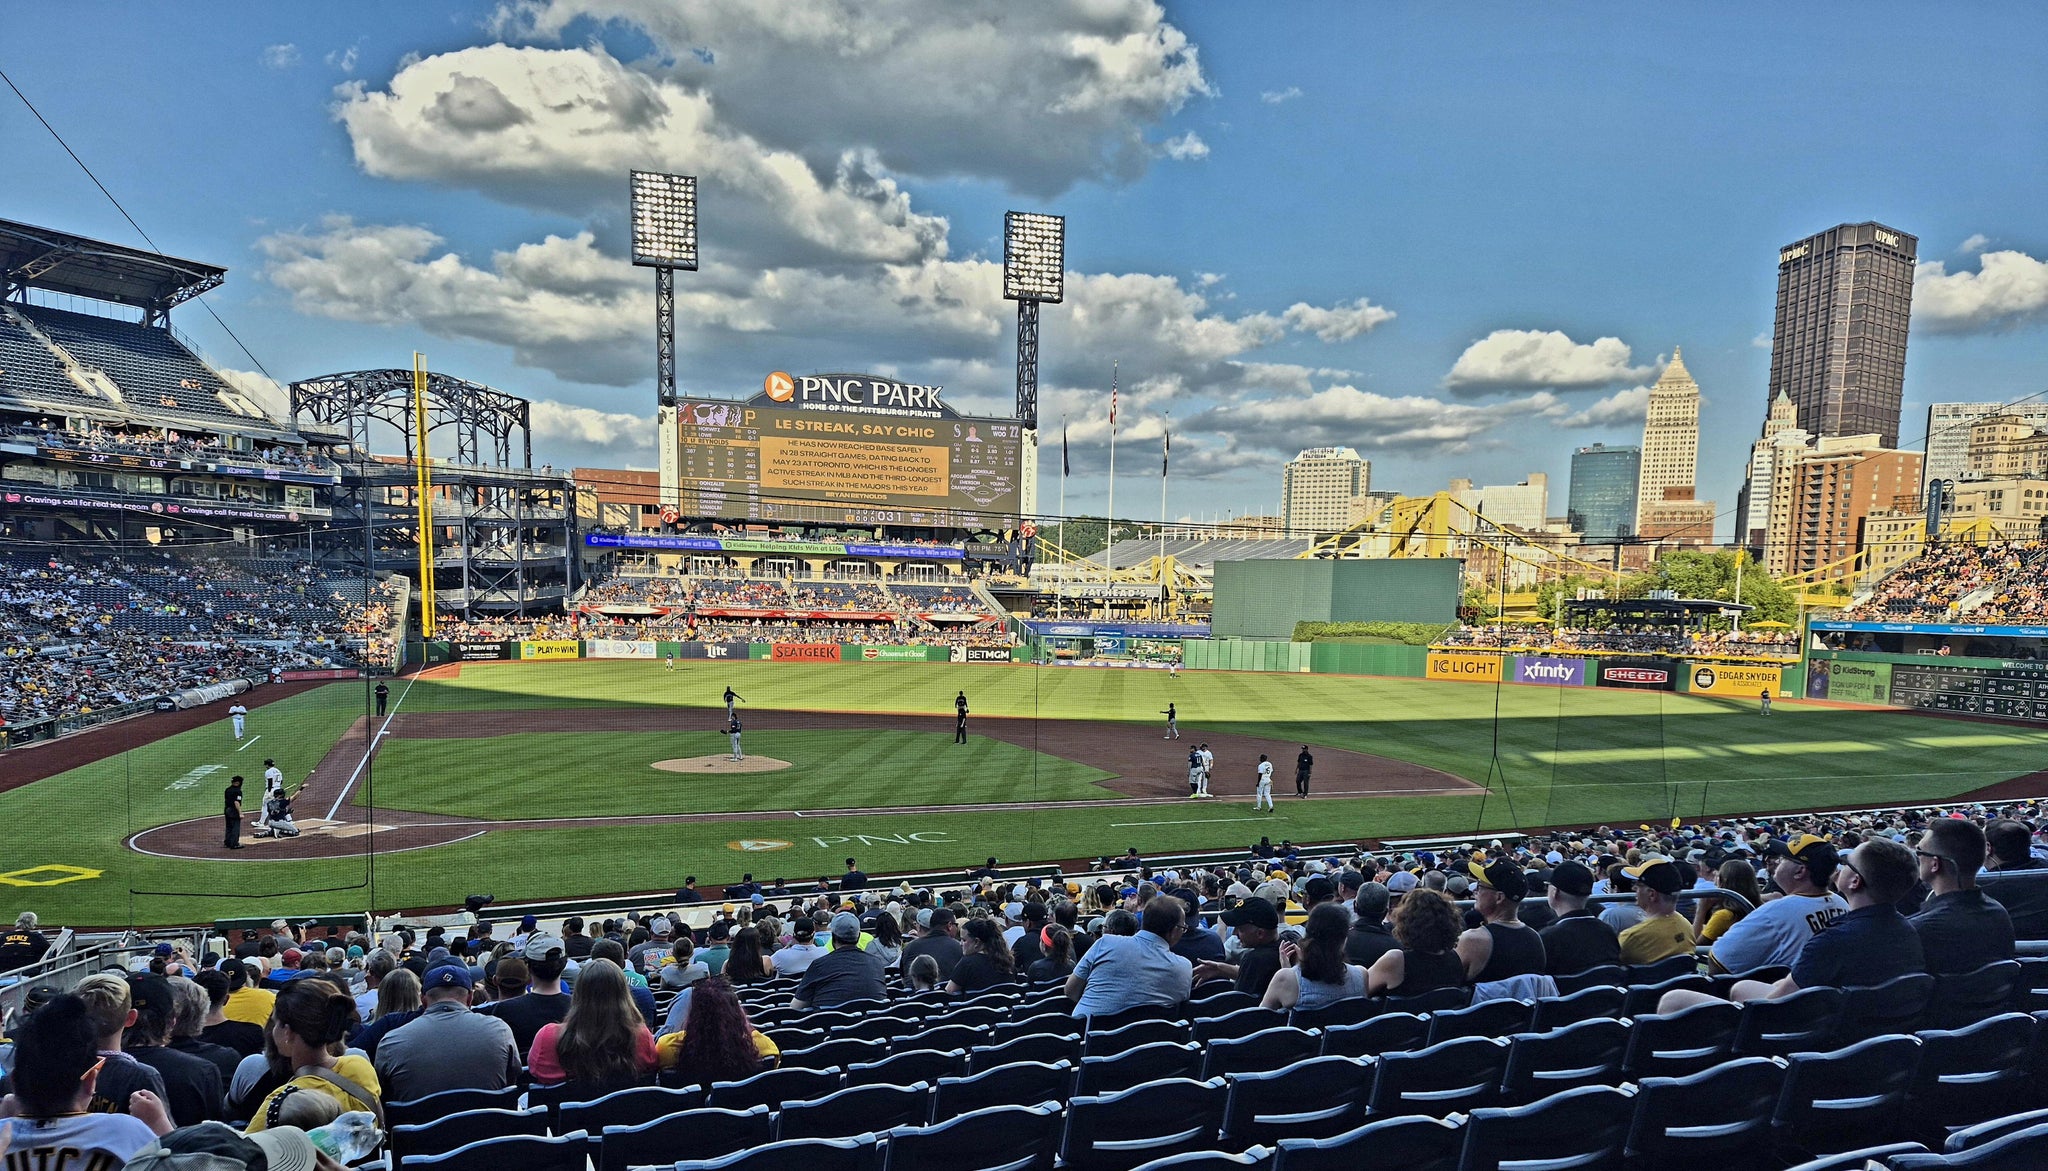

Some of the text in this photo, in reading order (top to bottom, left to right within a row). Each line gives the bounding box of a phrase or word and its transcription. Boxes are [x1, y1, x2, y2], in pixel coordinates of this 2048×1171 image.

[1876, 230, 1899, 248] UPMC
[1780, 244, 1809, 262] UPMC
[800, 377, 943, 409] PNC PARK
[802, 403, 827, 411] HOME
[842, 405, 857, 413] THE
[859, 406, 909, 416] PITTSBURGH
[909, 409, 942, 418] PIRATES
[745, 410, 756, 425] P
[775, 419, 935, 438] LE STREAK, SAY CHIC
[1010, 426, 1019, 438] 22
[838, 442, 875, 450] REACHED
[838, 452, 868, 461] GAMES,
[814, 461, 852, 470] TORONTO,
[24, 495, 60, 505] Cravings
[182, 506, 213, 516] Cravings
[629, 538, 657, 546] Helping
[1105, 589, 1146, 597] HEAD'S
[1649, 590, 1674, 600] TIME
[703, 643, 727, 658] Lite
[776, 646, 836, 659] SEATGEEK
[968, 650, 1010, 659] BETMGM
[1433, 659, 1496, 674] IC LIGHT
[1524, 662, 1575, 682] xfinity
[1842, 667, 1875, 677] KidStrong
[1608, 670, 1664, 682] SHEETZ
[1719, 671, 1744, 680] EDGAR
[1746, 672, 1777, 682] SNYDER
[810, 832, 958, 848] PNC
